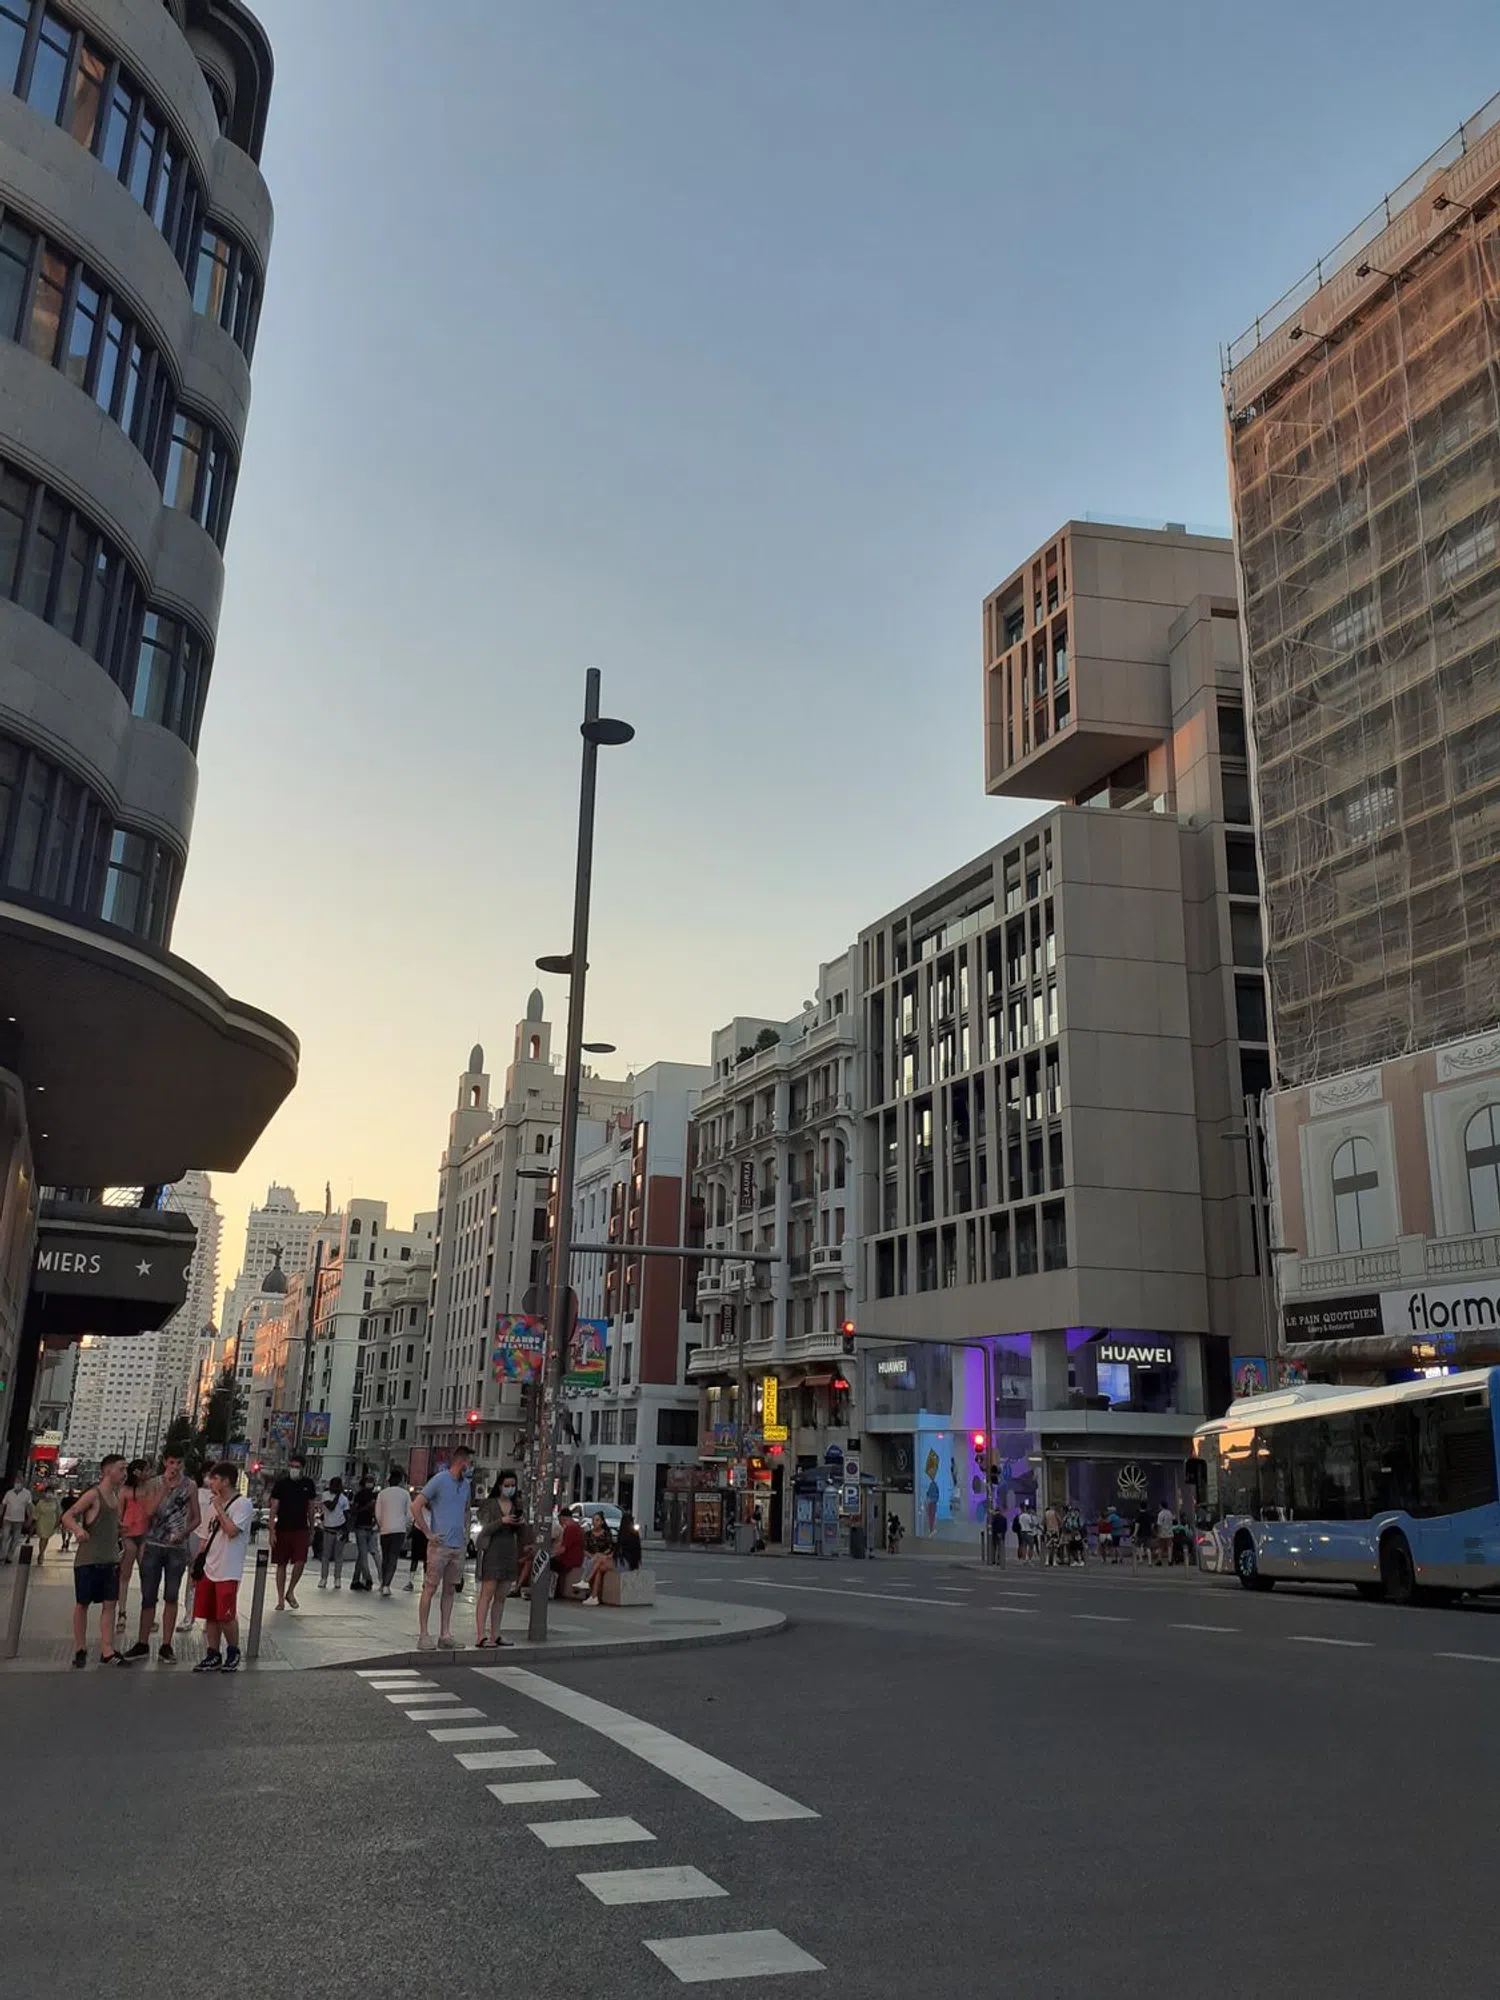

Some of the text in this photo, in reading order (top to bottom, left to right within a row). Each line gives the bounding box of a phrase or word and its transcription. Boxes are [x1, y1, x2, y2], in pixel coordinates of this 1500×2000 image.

[1286, 1307, 1378, 1327] LE PAIN QUOTIDIEN
[1408, 1292, 1500, 1330] florm
[1101, 1345, 1172, 1363] HUAWEI
[878, 1360, 907, 1374] HUAWEI
